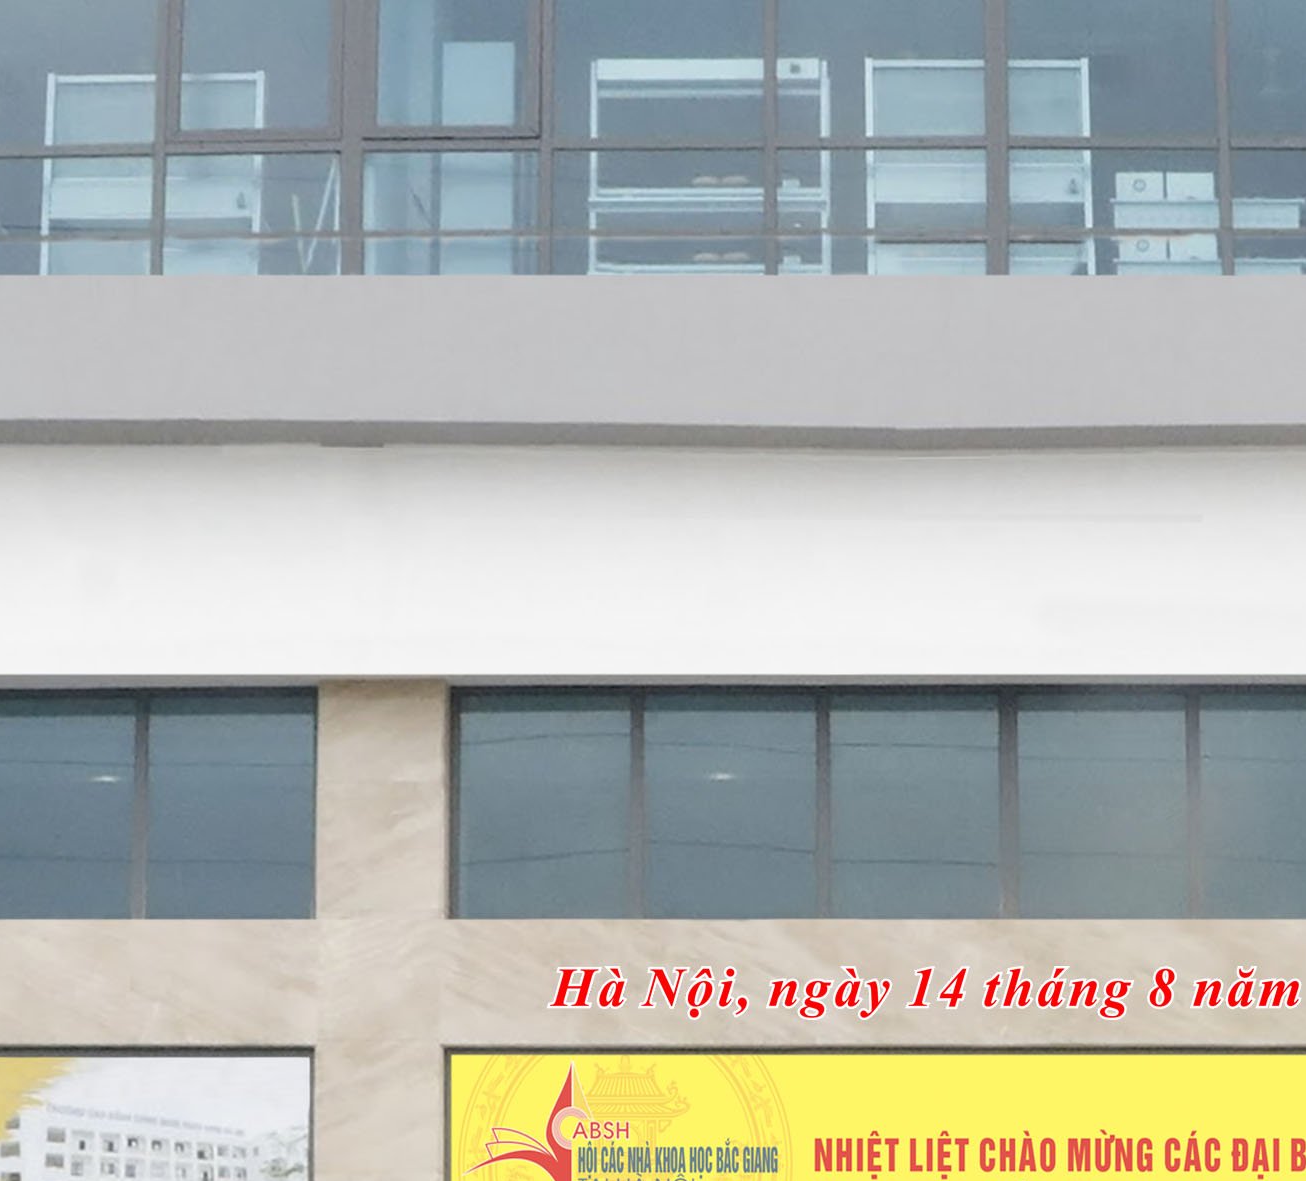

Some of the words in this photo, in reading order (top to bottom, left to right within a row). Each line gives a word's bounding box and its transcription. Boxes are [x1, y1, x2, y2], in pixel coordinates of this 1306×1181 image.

[577, 1140, 598, 1180] HỘI
[601, 1141, 625, 1174] CÁC
[627, 1140, 652, 1174] NHÀ
[655, 1146, 686, 1174] KHOA
[689, 1146, 713, 1180] HỌC
[716, 1137, 740, 1174] BẮC
[742, 1146, 779, 1174] GIANG
[814, 1130, 900, 1180] NHIỆT
[909, 1130, 970, 1180] LIỆT
[979, 1130, 1056, 1173] CHÀO
[1067, 1129, 1153, 1173] MỪNG
[1164, 1130, 1221, 1173] CÁC
[1231, 1138, 1280, 1180] ĐẠI
